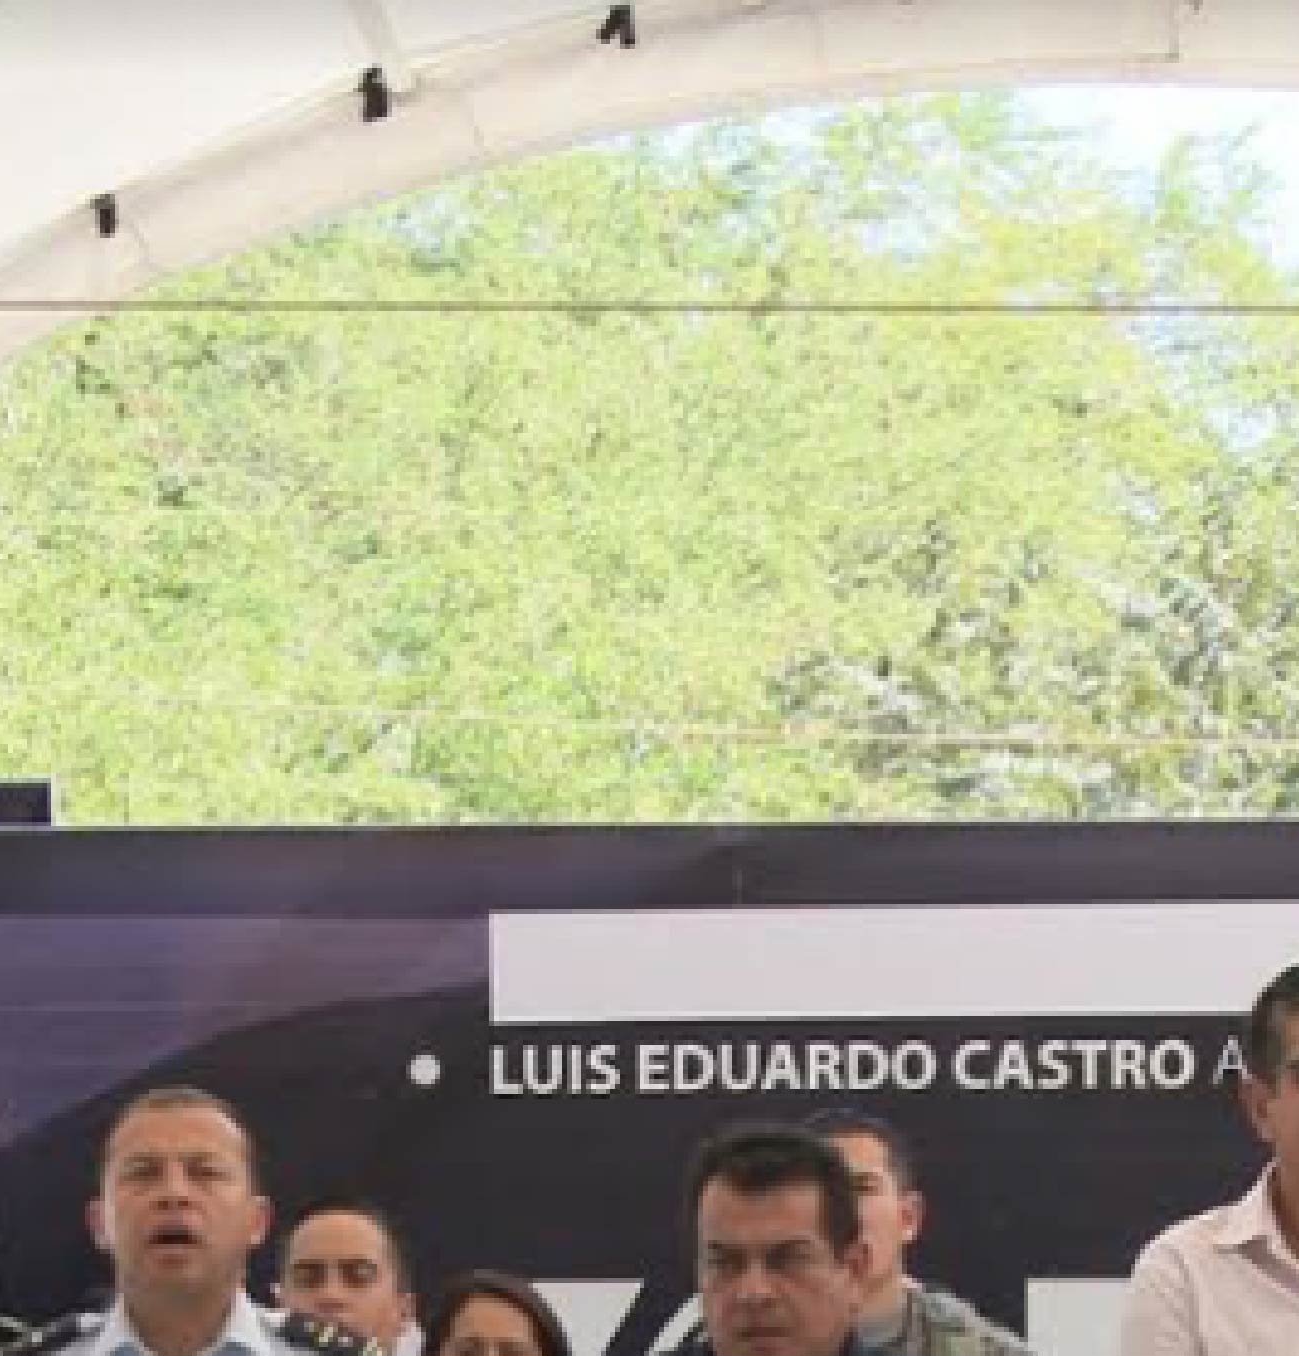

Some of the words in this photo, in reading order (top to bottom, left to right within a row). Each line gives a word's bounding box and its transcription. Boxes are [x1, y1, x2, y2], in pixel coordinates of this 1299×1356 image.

[490, 1044, 622, 1095] LUIS
[634, 1040, 937, 1091] EDUARDO
[951, 1037, 1196, 1090] CASTRO
